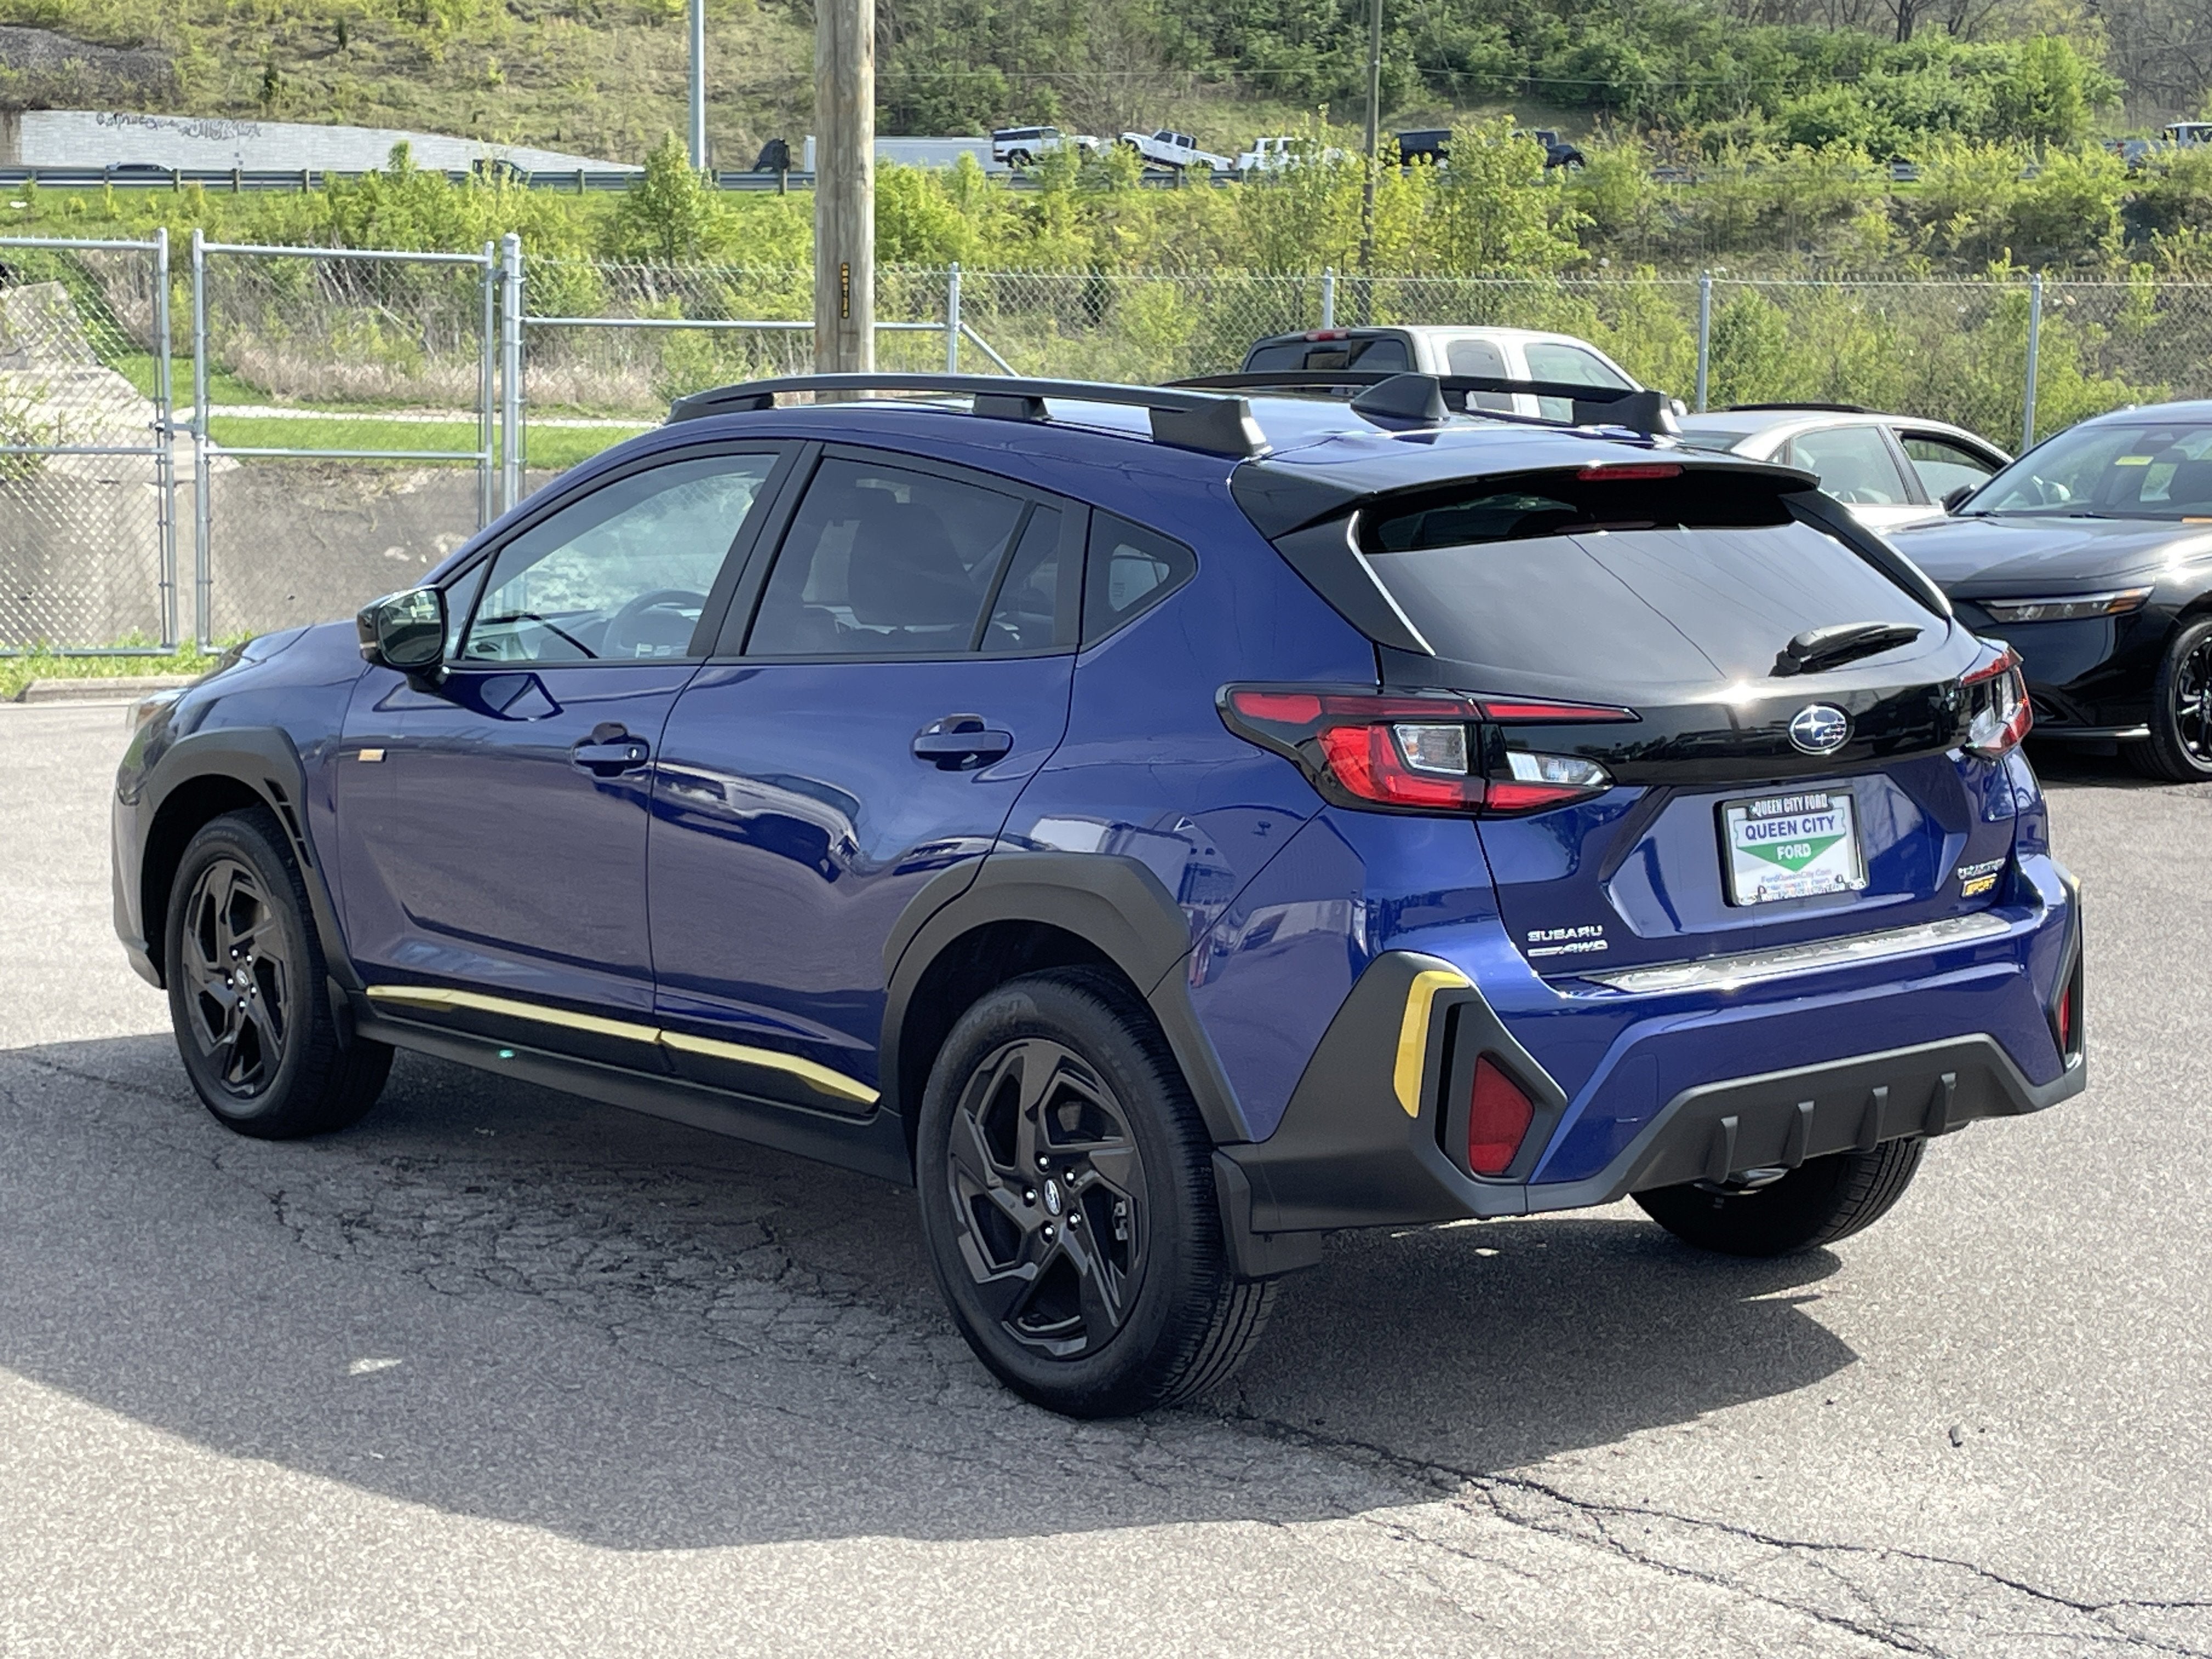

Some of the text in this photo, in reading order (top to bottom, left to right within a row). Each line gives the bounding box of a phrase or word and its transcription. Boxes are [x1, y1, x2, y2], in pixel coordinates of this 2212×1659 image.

[1756, 793, 1828, 817] QUEEN CITY FORD
[1745, 815, 1835, 840] QUEEN CITY
[1776, 843, 1812, 860] FORD
[1527, 924, 1603, 942] SUBARU
